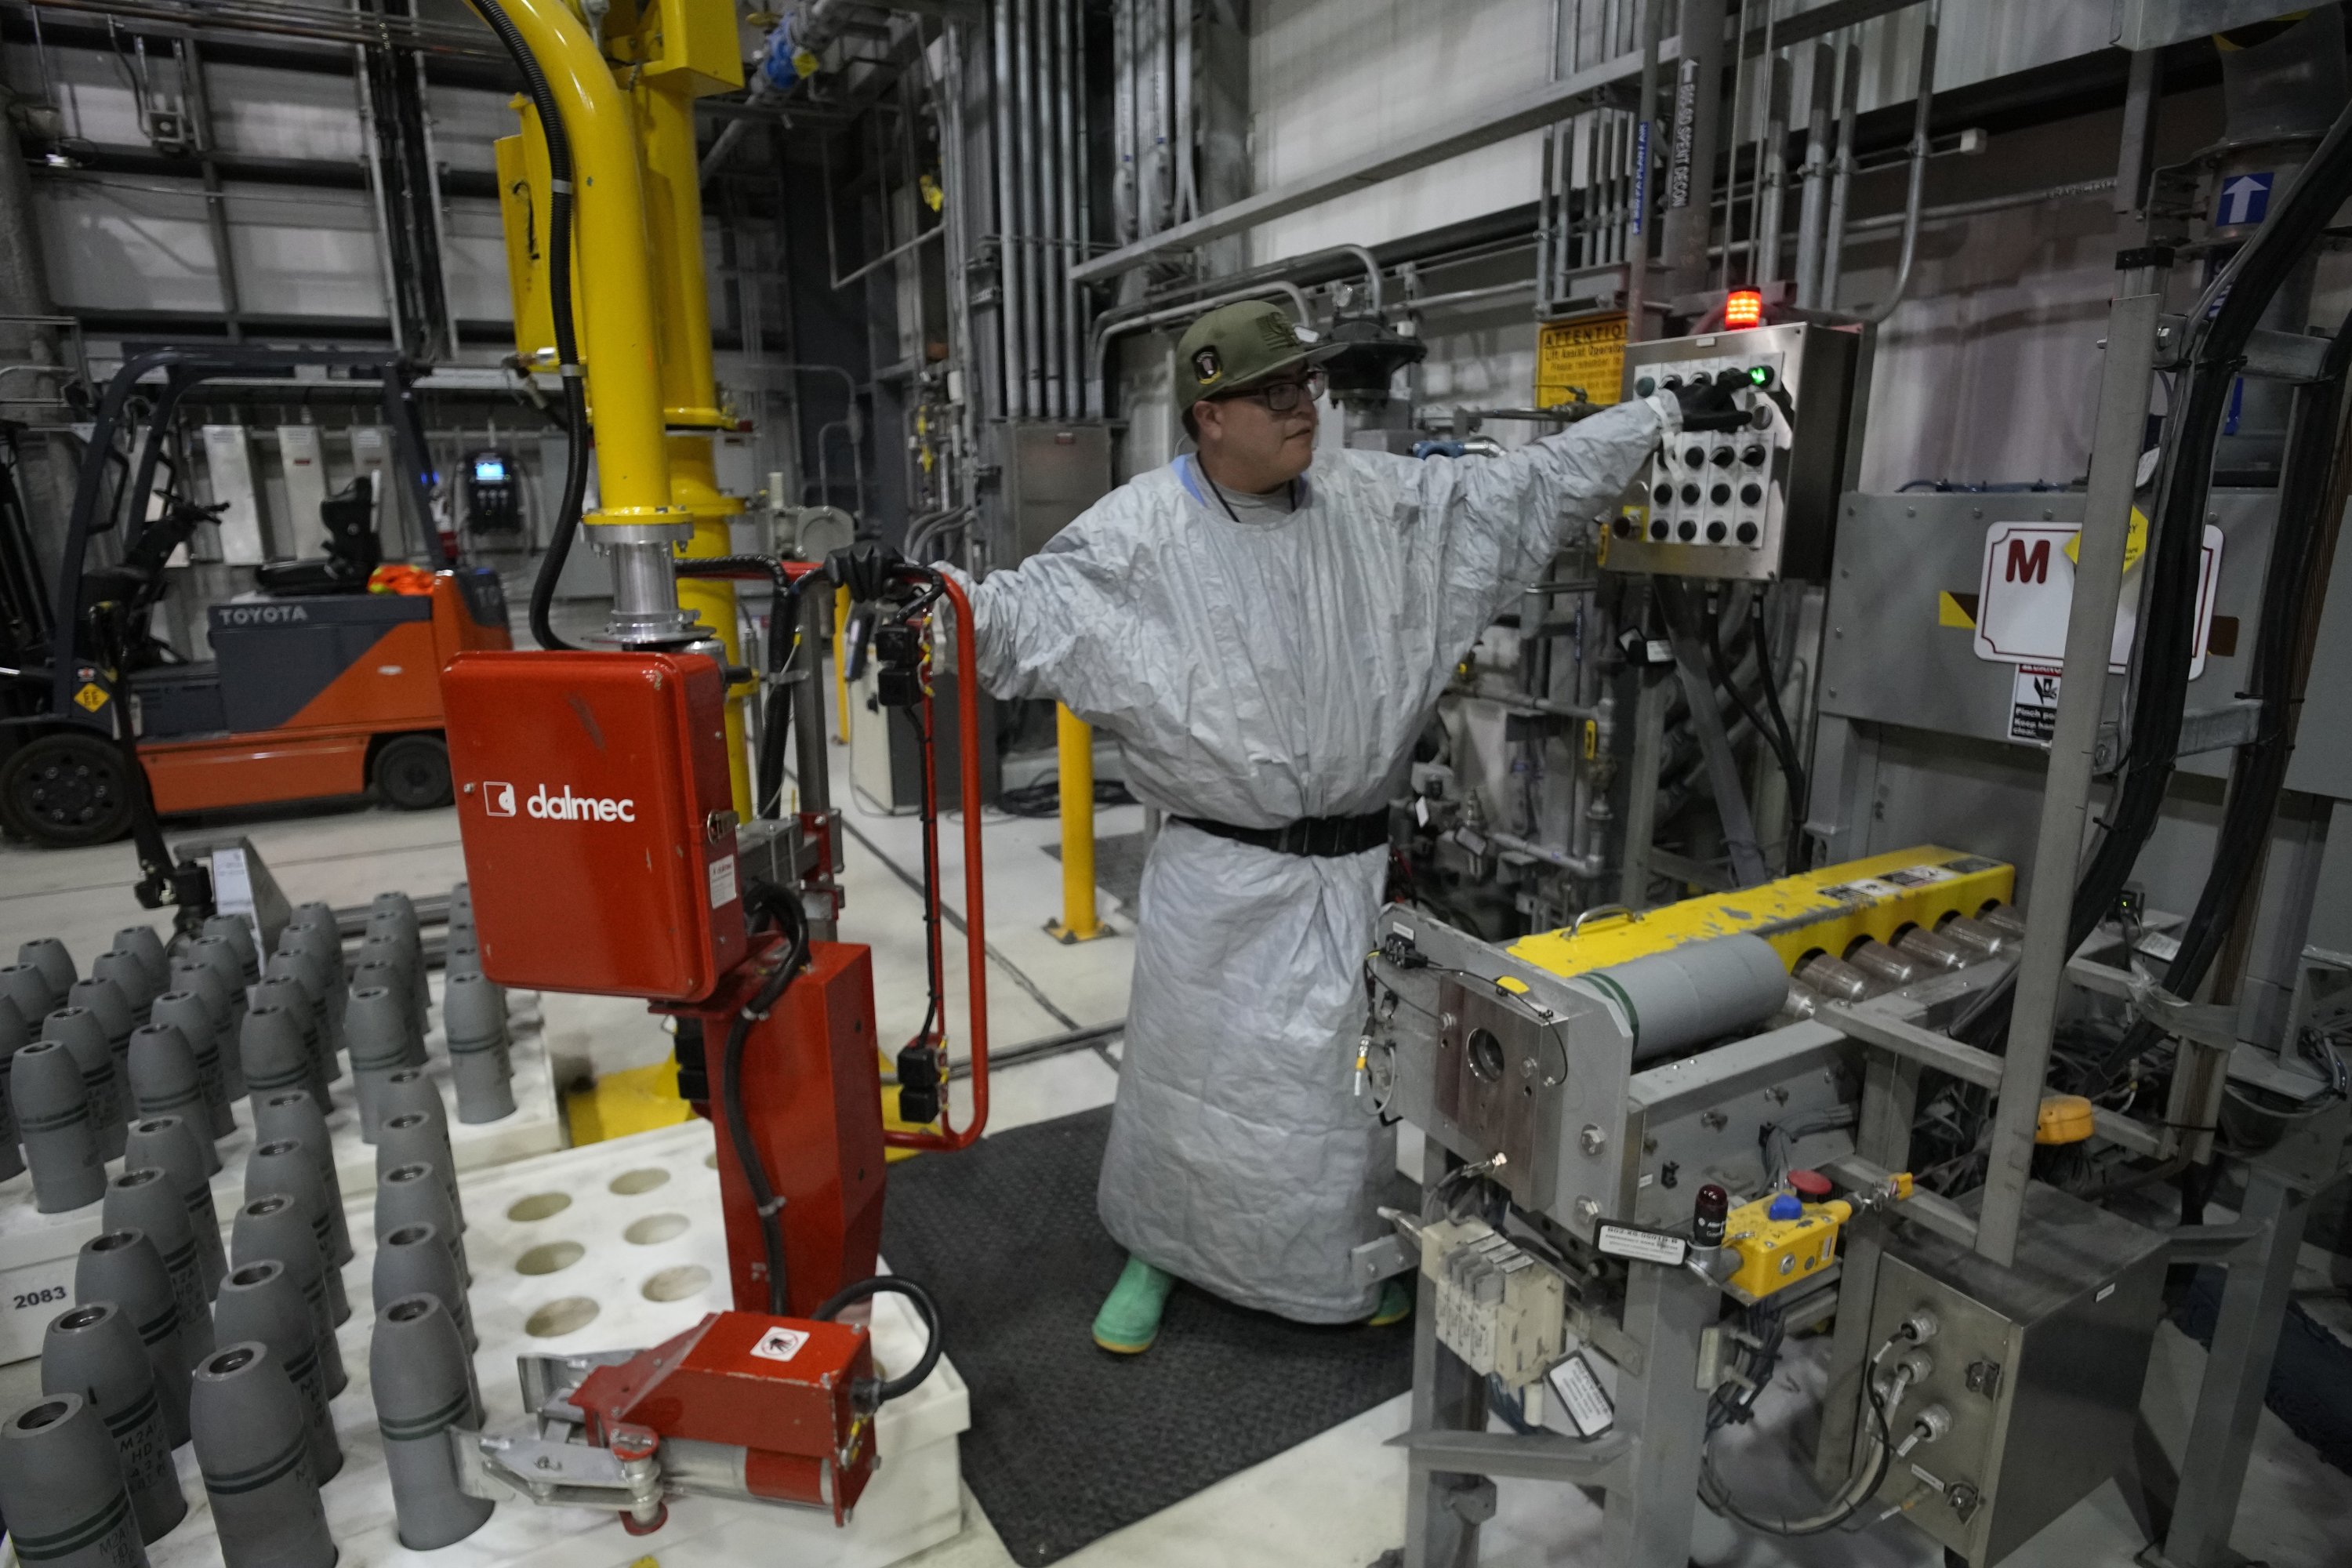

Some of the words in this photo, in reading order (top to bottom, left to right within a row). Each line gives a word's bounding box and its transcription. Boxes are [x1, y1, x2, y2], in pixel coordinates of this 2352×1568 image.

[1675, 125, 1693, 164] SPENT
[1672, 165, 1690, 208] DECON
[2005, 539, 2050, 584] M
[218, 605, 307, 626] TOYOTA
[2016, 706, 2041, 718] Pinch
[527, 783, 635, 822] dalmec
[13, 1286, 66, 1310] 2083
